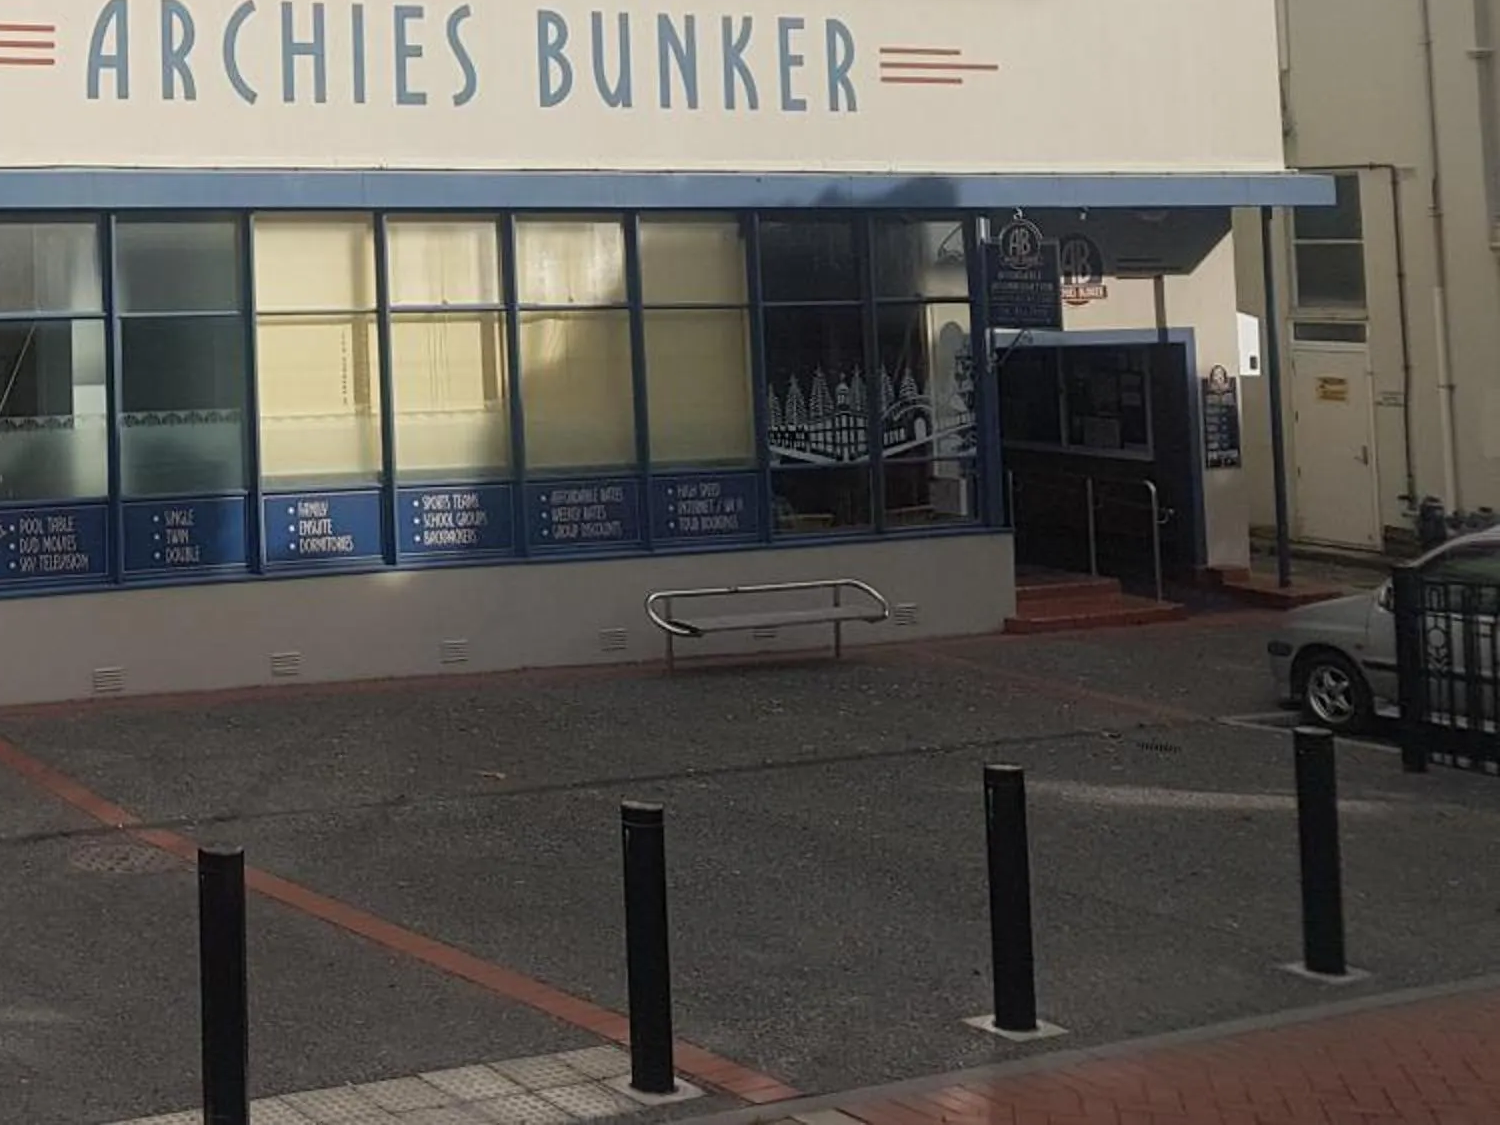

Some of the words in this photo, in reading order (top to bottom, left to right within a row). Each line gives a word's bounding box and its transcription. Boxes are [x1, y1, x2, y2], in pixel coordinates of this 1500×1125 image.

[537, 10, 857, 113] BUNKER
[297, 499, 329, 517] FAMILY
[422, 494, 450, 510] SPORTS
[452, 492, 479, 508] TEAMS
[20, 517, 43, 535] POOL
[48, 515, 75, 532] TABLE
[164, 508, 195, 526] SINGLE
[423, 512, 454, 528] SCHOOL
[456, 510, 488, 526] GROUPS
[166, 528, 189, 544] TWIN
[299, 518, 332, 536] ENSUITE
[20, 536, 40, 554] DVD
[42, 535, 77, 552] MOVIES
[299, 535, 354, 554] DORMITORIES
[423, 528, 478, 546] BACKPACKERS
[39, 553, 89, 572] TELEVISION
[165, 545, 201, 563] DOUBLE
